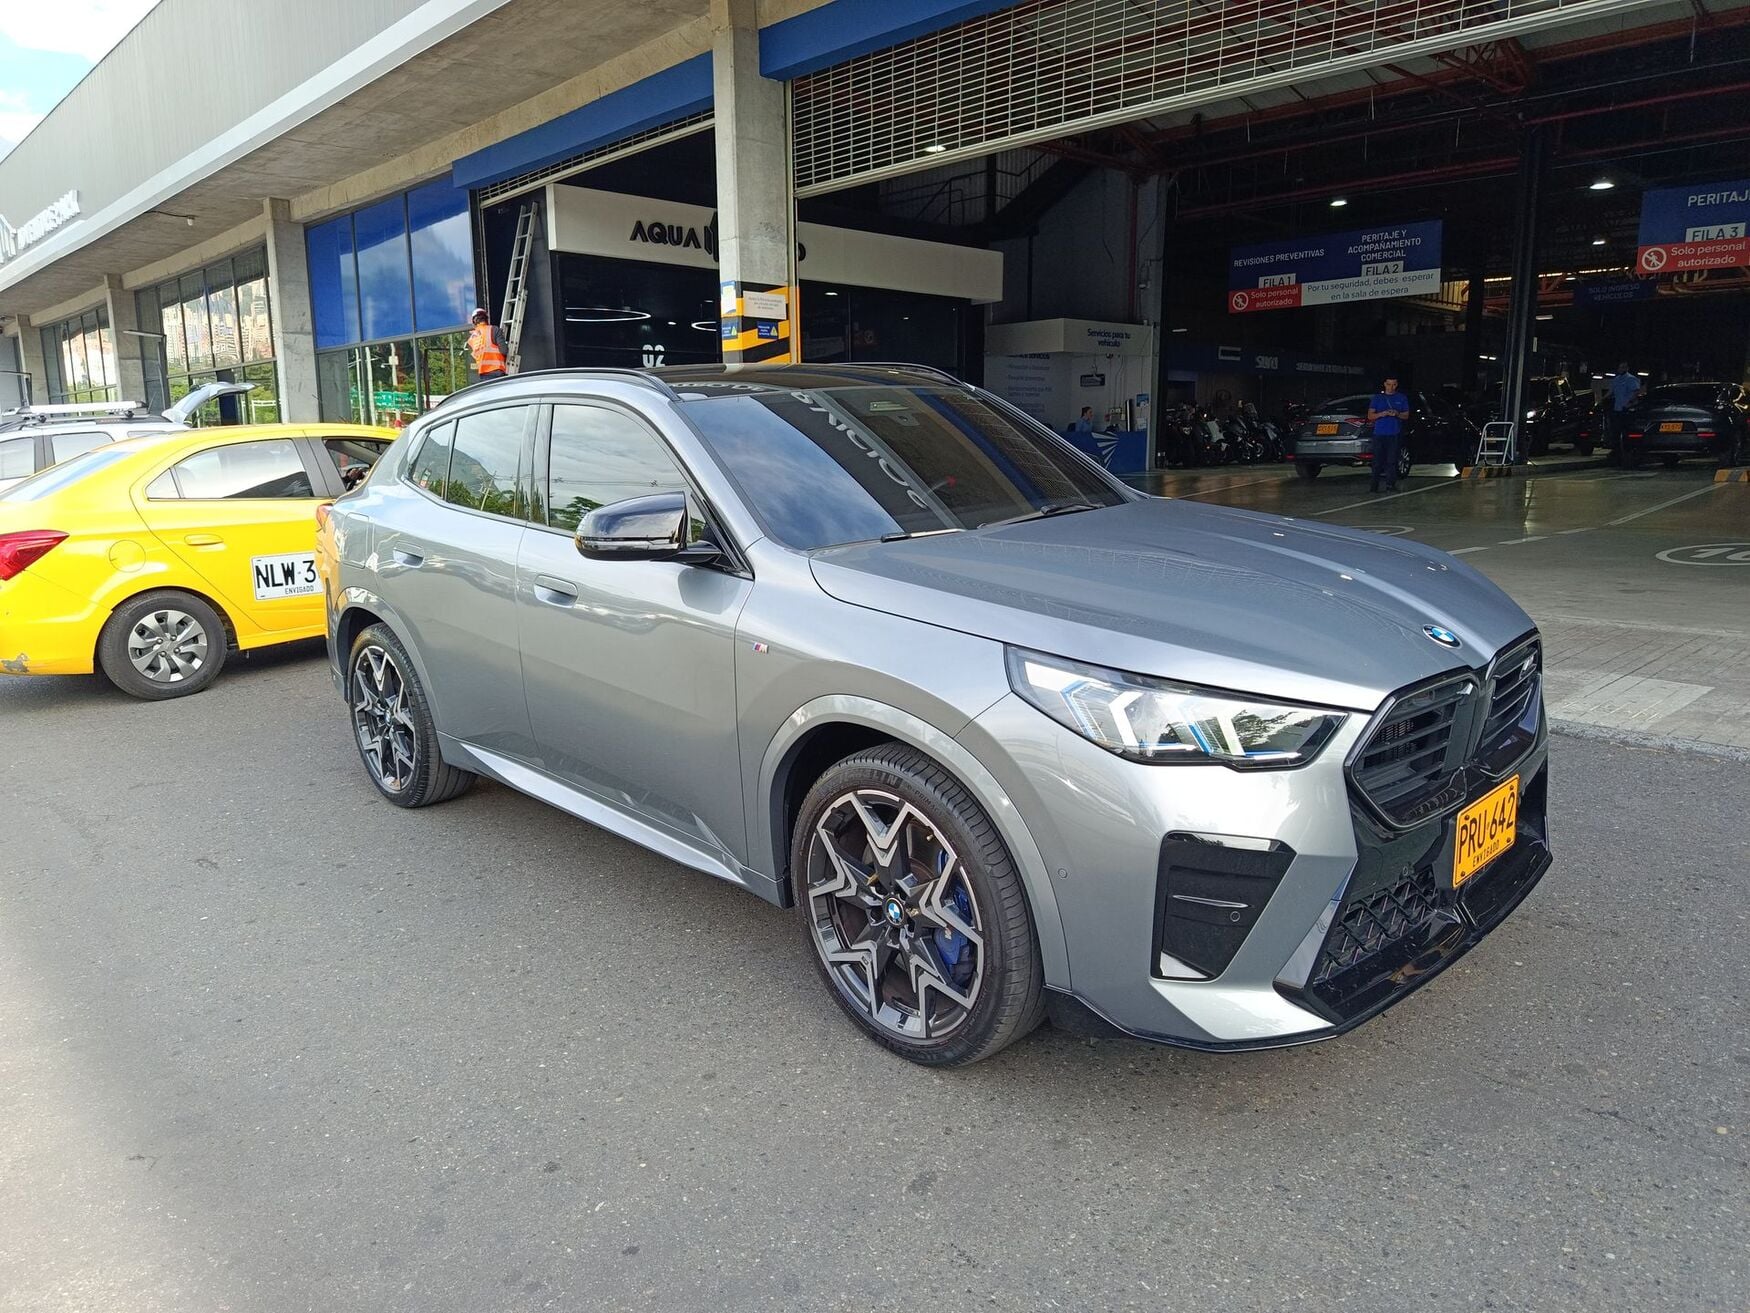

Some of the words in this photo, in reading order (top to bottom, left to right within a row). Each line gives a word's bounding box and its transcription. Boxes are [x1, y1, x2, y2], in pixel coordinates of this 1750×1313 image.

[1687, 189, 1750, 207] PERITAJ
[629, 220, 701, 249] AQUA
[1361, 230, 1400, 243] PERITAJE
[1401, 229, 1407, 237] Y
[1692, 228, 1725, 241] FILA
[1729, 226, 1739, 238] 3
[1347, 237, 1422, 254] ACOMPAÑAMIENTO
[1671, 246, 1695, 256] Solo
[1697, 241, 1746, 255] personal
[1233, 255, 1275, 267] REVISIONES
[1275, 248, 1325, 262] PREVENTIVAS
[1360, 249, 1407, 262] COMERCIAL
[1677, 255, 1736, 267] autorizado
[1365, 265, 1390, 276] FILA
[1392, 263, 1399, 274] 2
[1263, 276, 1285, 287] FILA
[1330, 279, 1372, 290] seguridad,
[1373, 276, 1398, 285] debes
[1402, 273, 1434, 283] esperar
[1250, 290, 1267, 299] Solo
[1267, 287, 1299, 298] personal
[1351, 291, 1367, 299] sala
[1380, 287, 1409, 296] espera
[1255, 298, 1293, 308] autorizado
[1087, 328, 1111, 338] Servicios
[1111, 332, 1124, 340] para
[284, 585, 315, 595] ENVIGADO
[1472, 839, 1500, 868] ENVIGADO
